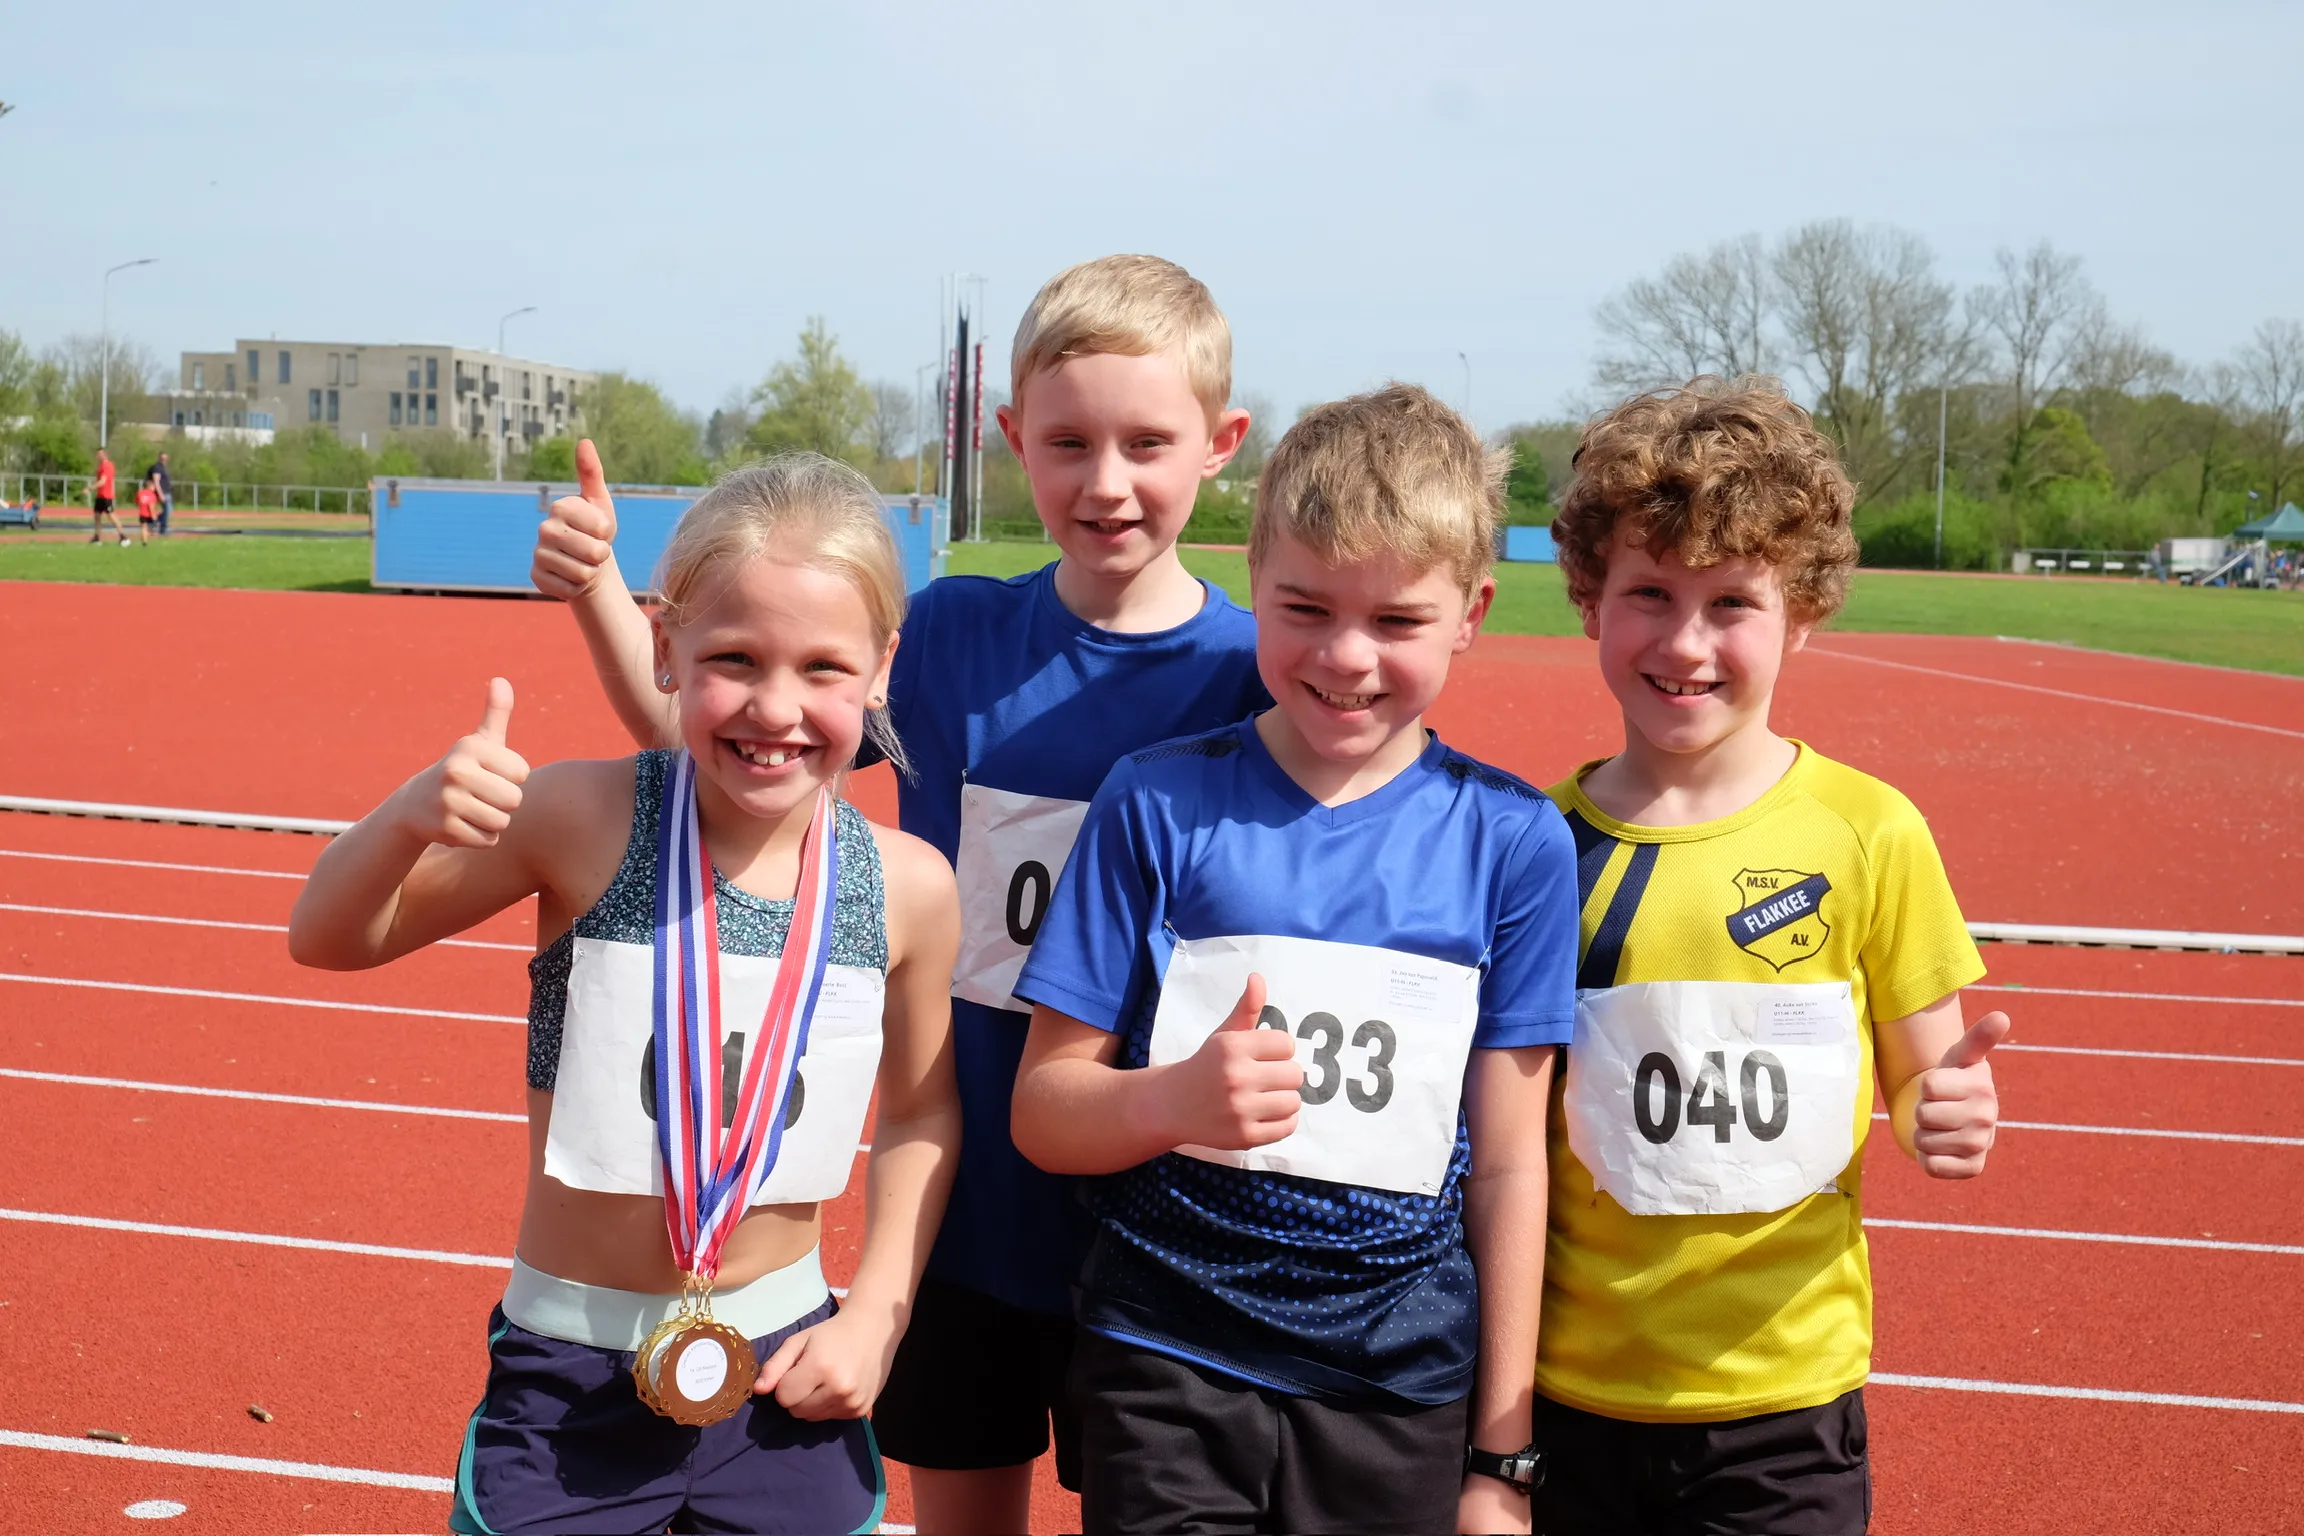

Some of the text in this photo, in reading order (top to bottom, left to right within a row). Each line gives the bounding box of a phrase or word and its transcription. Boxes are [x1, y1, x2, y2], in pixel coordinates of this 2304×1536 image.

[1746, 876, 1779, 889] M.S.V.
[1743, 889, 1811, 934] FLAKKEE
[1790, 933, 1809, 947] A.V.
[1633, 1049, 1789, 1144] 040
